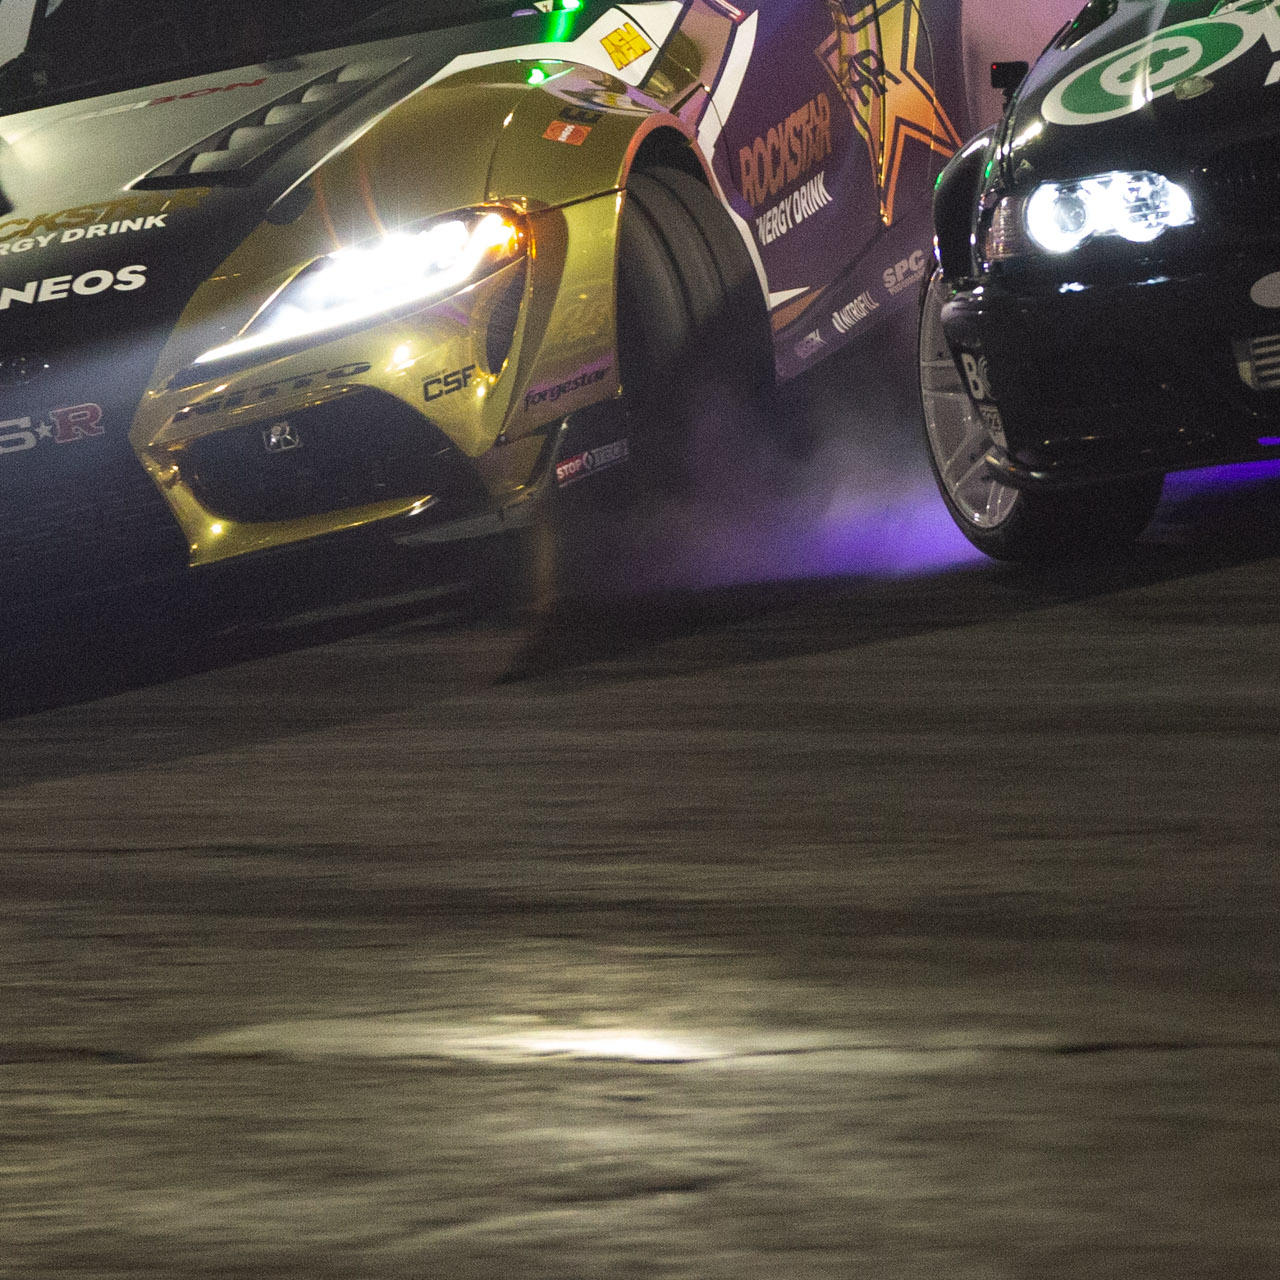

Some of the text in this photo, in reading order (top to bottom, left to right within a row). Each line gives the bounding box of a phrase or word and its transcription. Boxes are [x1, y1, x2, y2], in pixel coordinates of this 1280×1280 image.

[739, 91, 833, 209] ROCKSTAR
[791, 170, 834, 225] DRINK
[60, 213, 169, 244] DRINK
[883, 249, 926, 290] SPC
[422, 363, 477, 402] CSF
